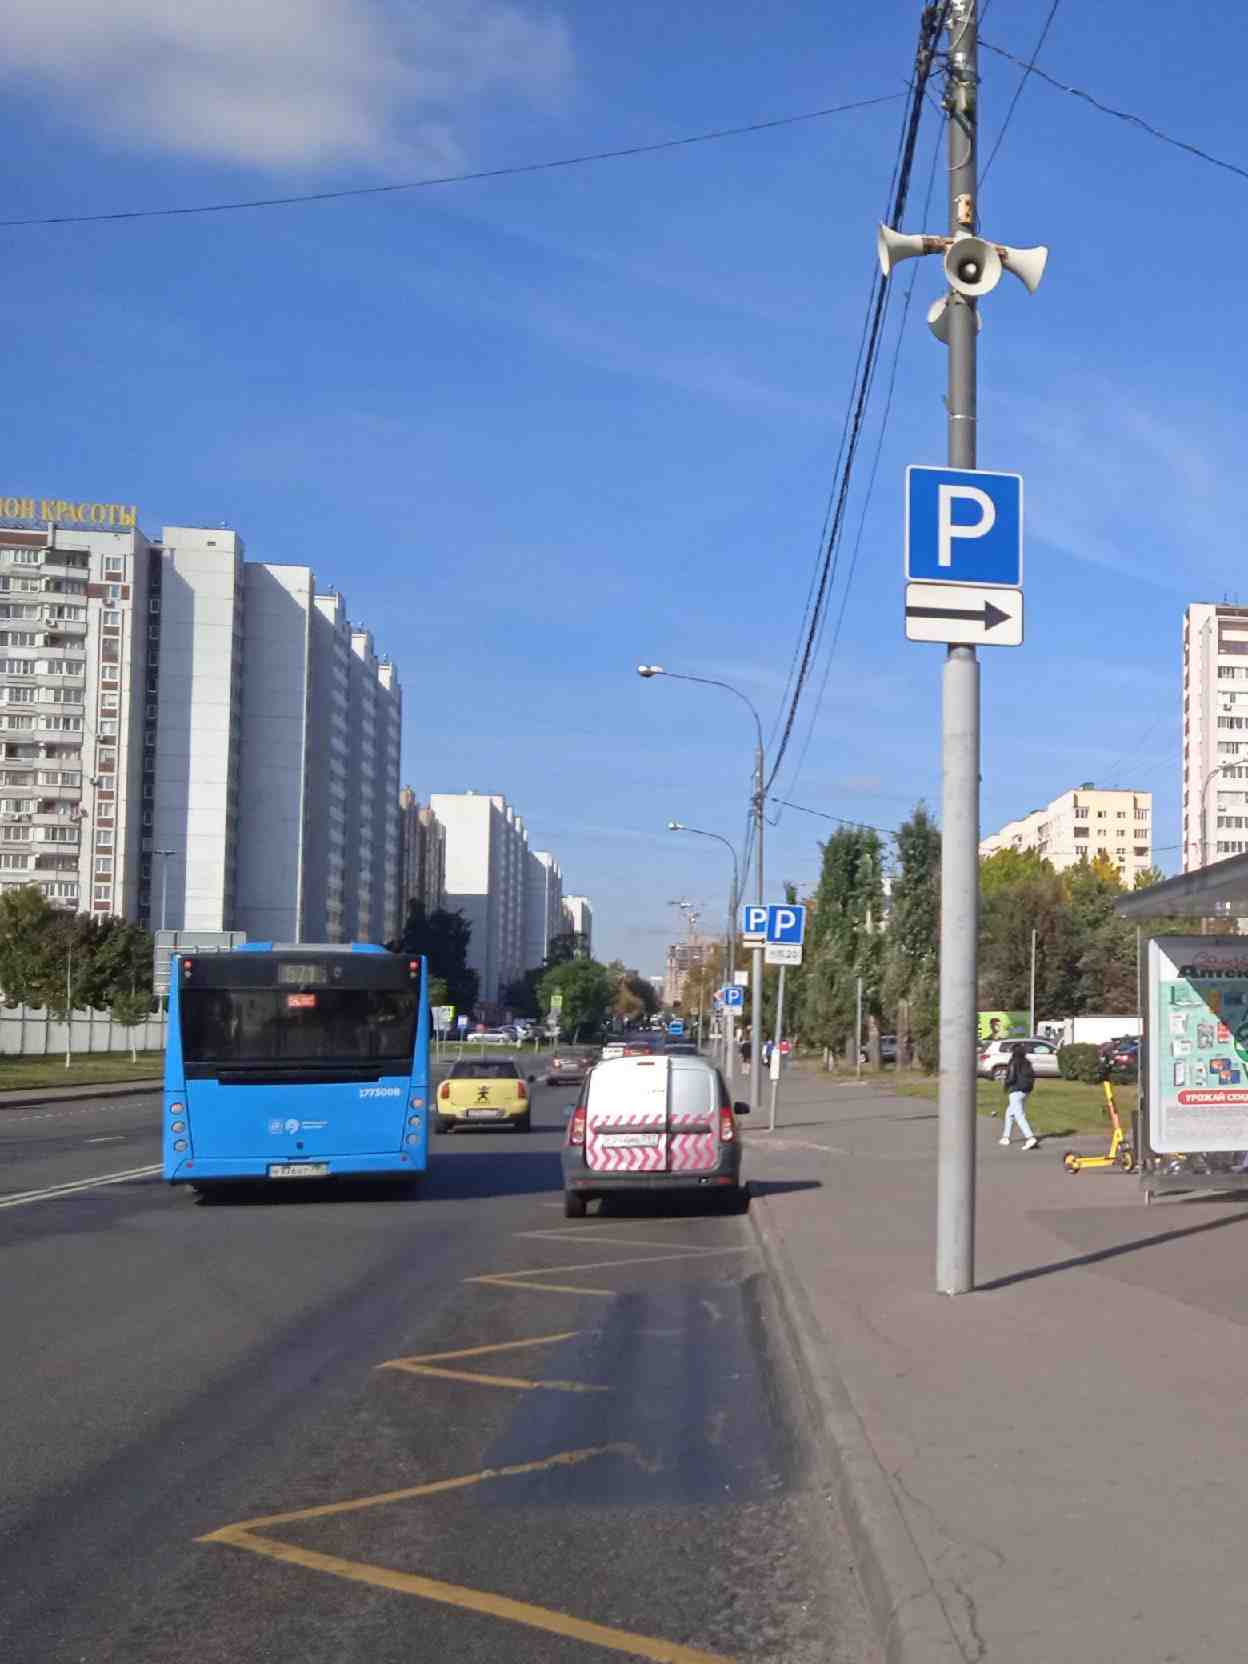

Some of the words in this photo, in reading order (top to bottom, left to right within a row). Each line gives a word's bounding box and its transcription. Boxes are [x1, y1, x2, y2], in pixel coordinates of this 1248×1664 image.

[41, 497, 137, 527] КРАСОТЫ
[938, 484, 996, 567] P
[750, 908, 766, 931] P
[774, 910, 796, 938] P
[728, 990, 740, 1005] P
